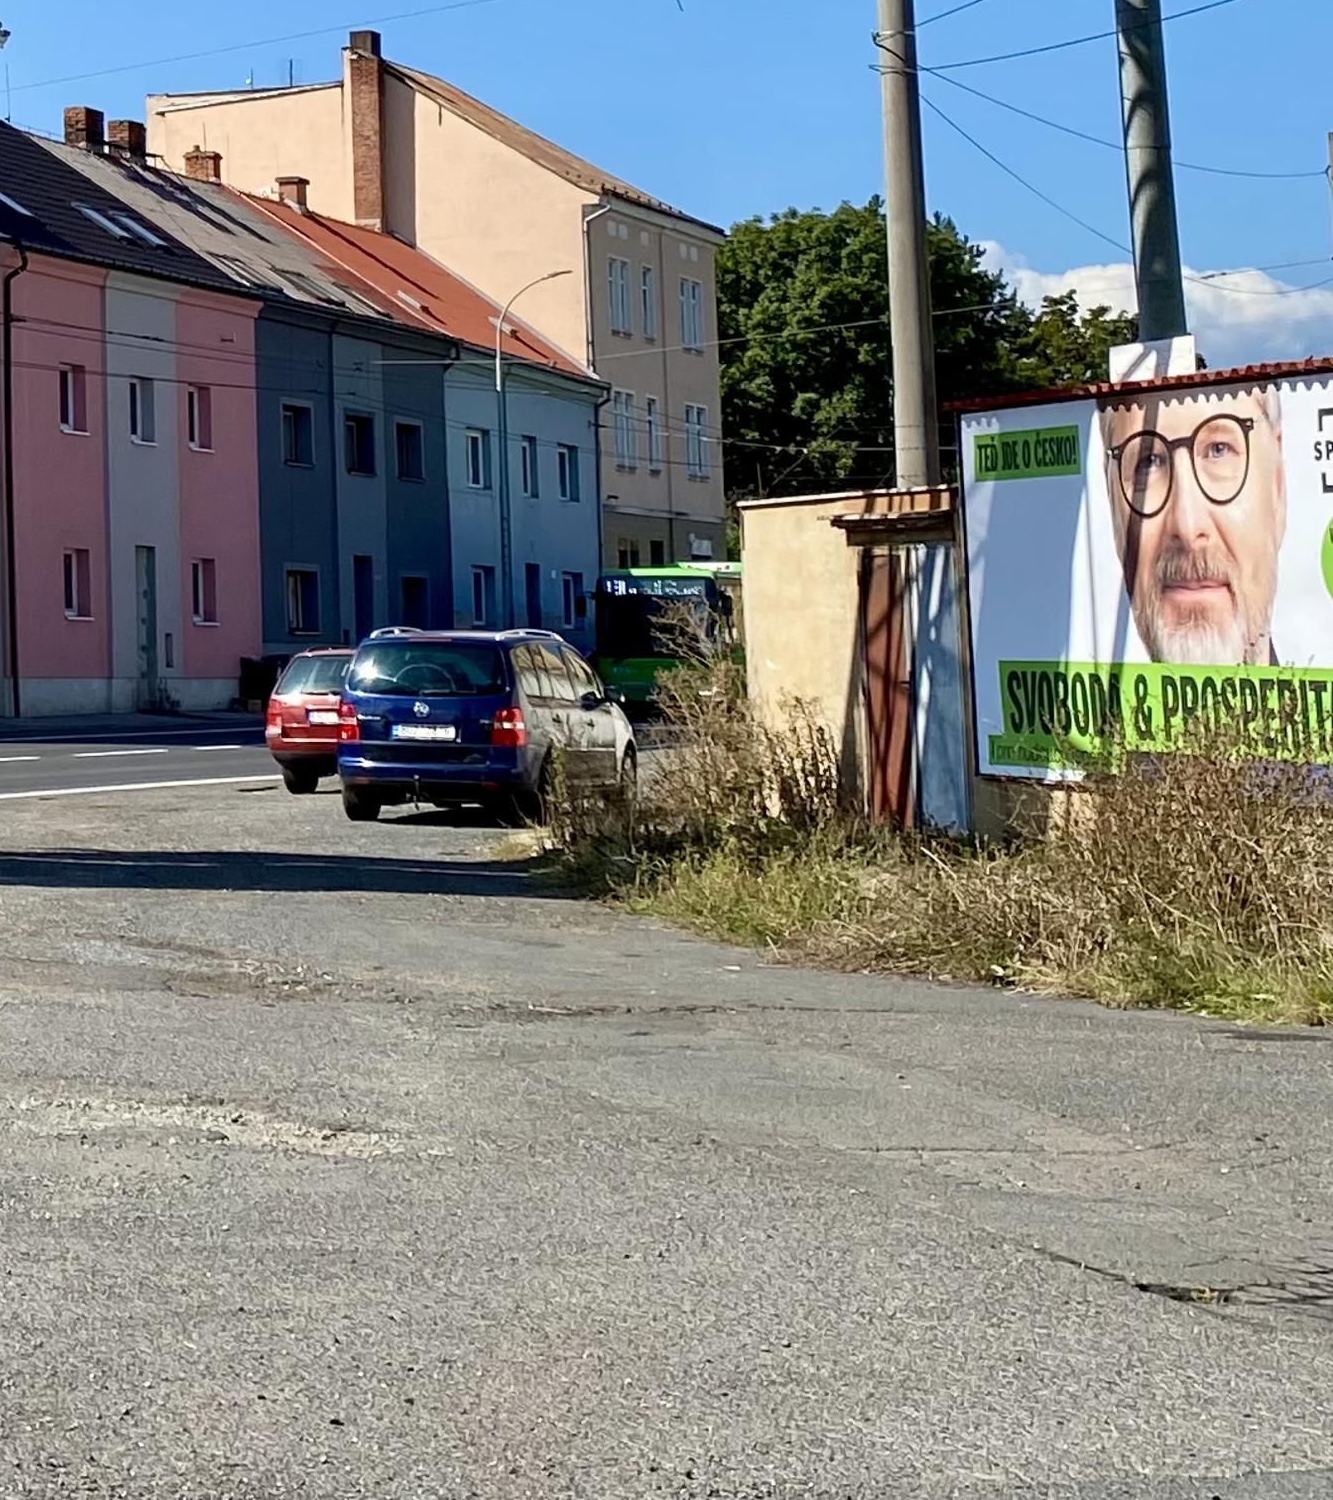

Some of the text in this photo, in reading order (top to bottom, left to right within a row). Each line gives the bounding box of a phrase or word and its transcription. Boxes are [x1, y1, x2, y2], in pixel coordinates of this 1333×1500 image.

[977, 430, 1078, 474] TEĎ JDE O ČESKO!
[1006, 669, 1333, 756] SVOBODA & PROSPERIT
